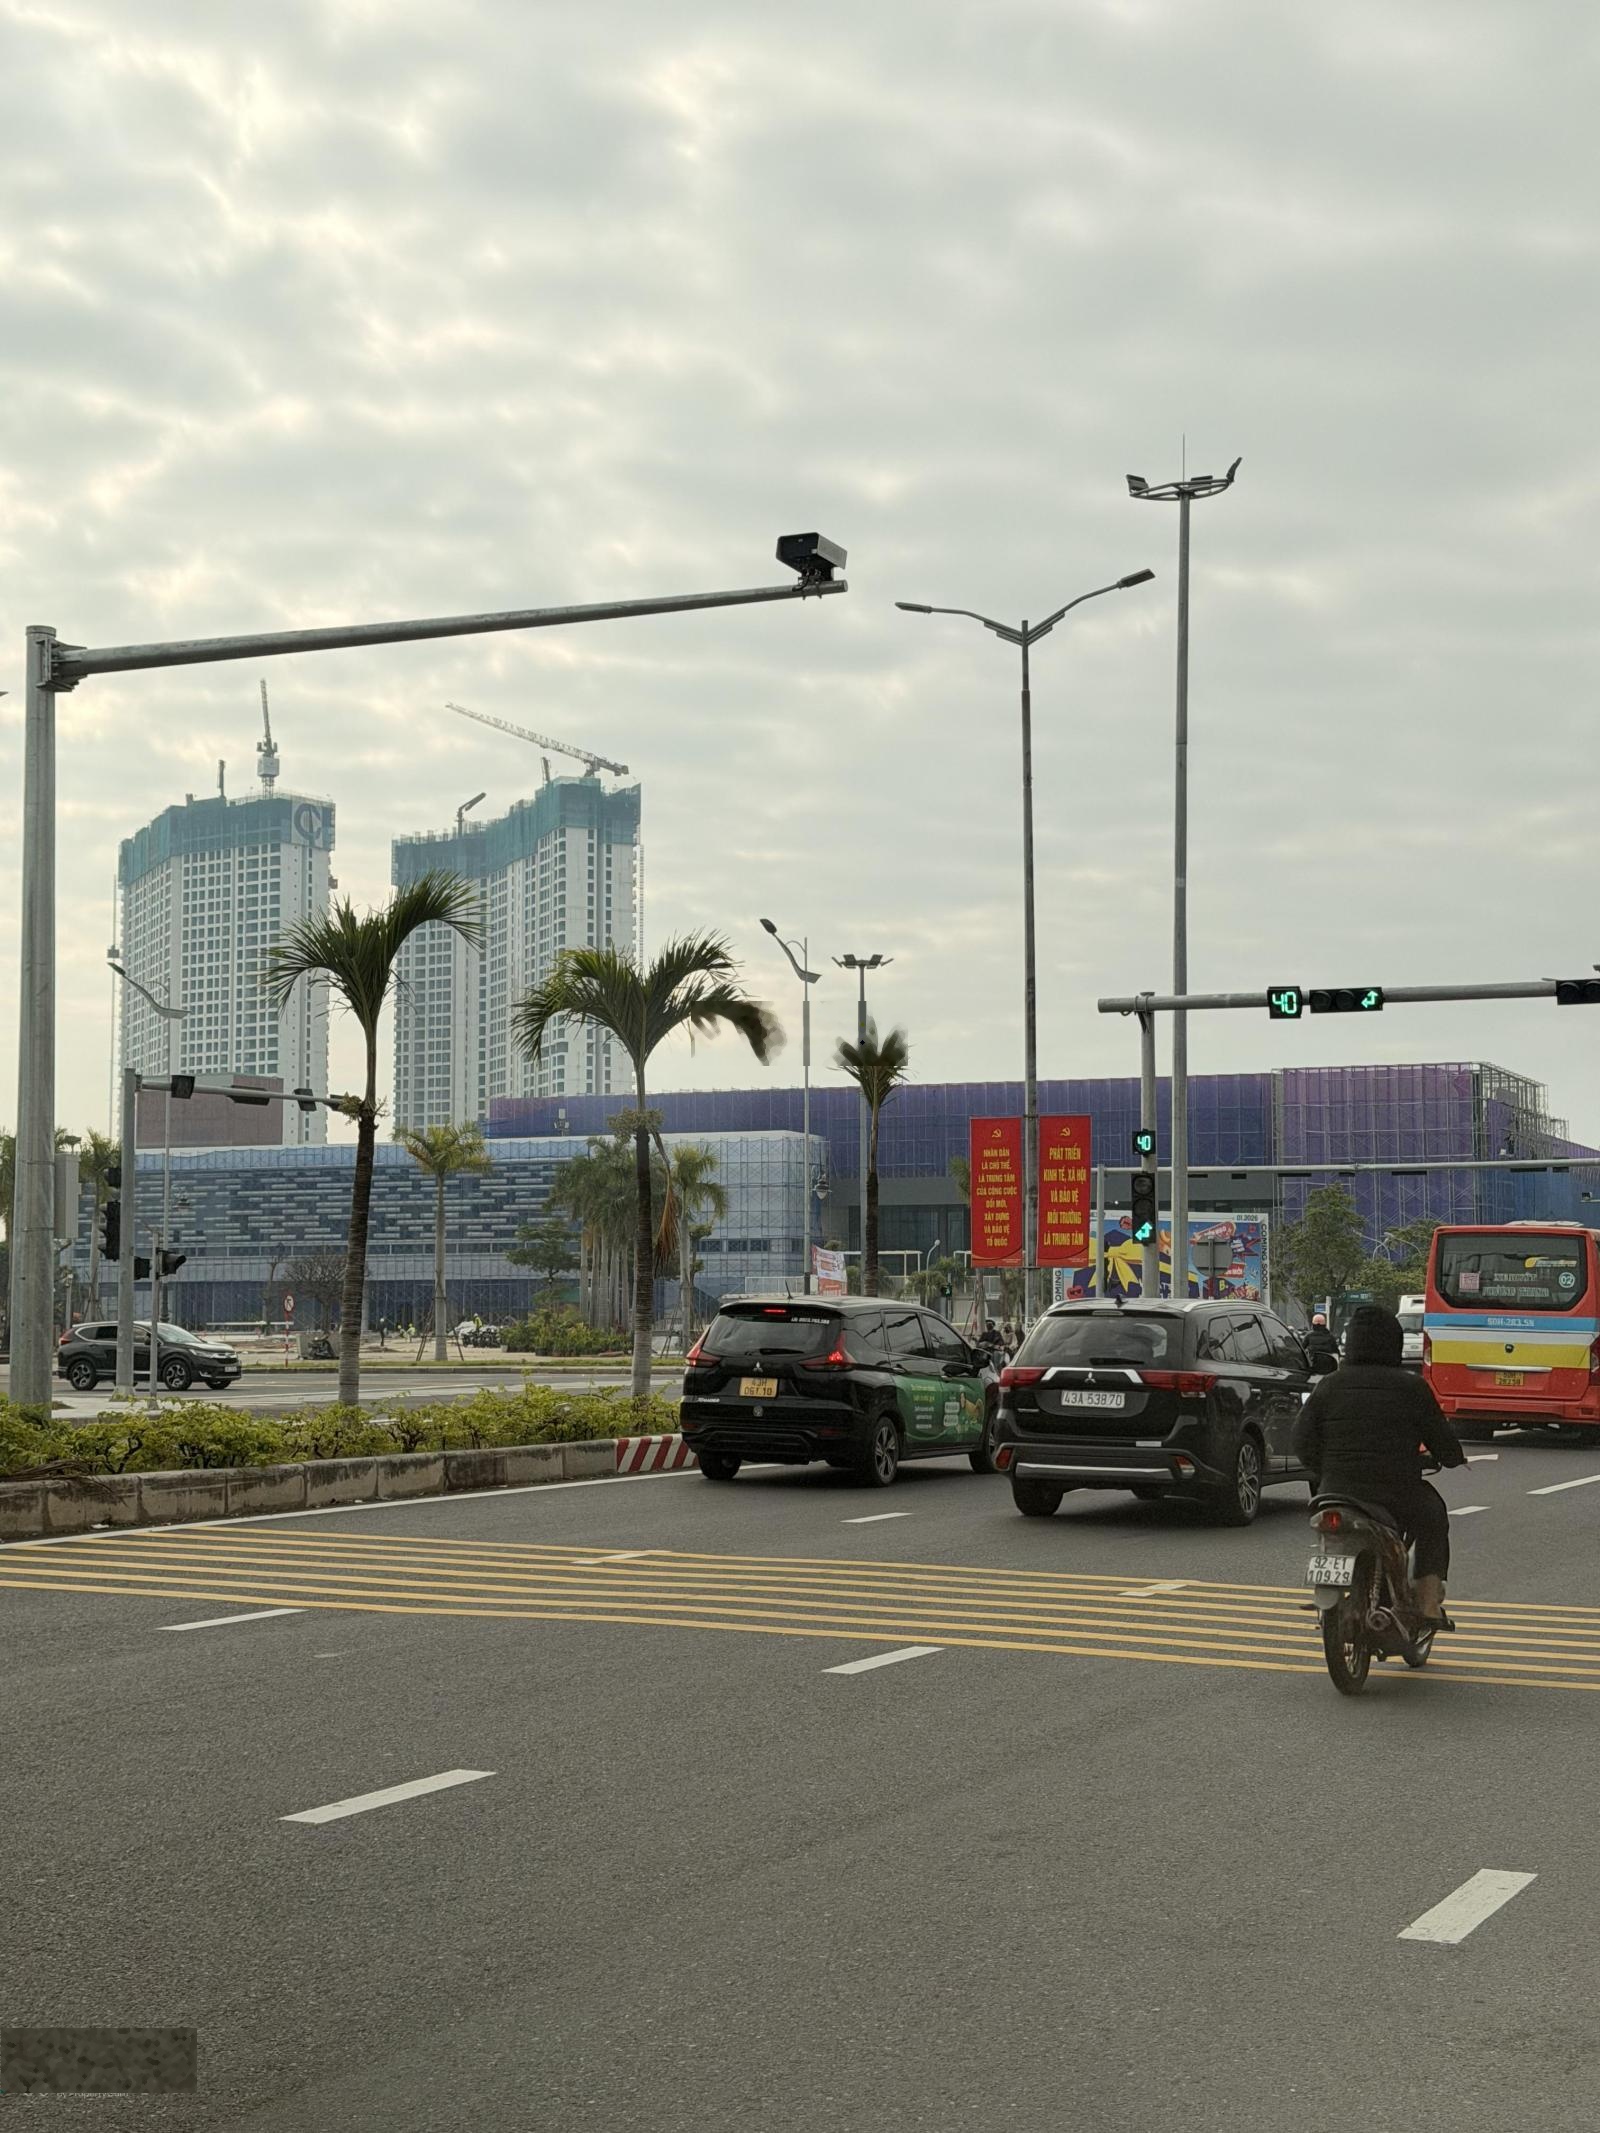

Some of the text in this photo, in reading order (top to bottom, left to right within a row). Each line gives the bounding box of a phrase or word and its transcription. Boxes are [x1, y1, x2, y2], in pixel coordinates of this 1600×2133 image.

[1271, 991, 1297, 1014] 40
[1137, 1135, 1151, 1151] 40
[1049, 1143, 1081, 1160] PHÁT TRIỂN
[1043, 1165, 1087, 1185] KINH TẾ, XÃ HỘI
[1050, 1186, 1079, 1206] VÀ BẢO VỆ
[1047, 1209, 1059, 1225] MÔI
[1059, 1209, 1082, 1225] TRƯỜNG
[1043, 1230, 1083, 1246] LÀ TRUNG TÂM
[1261, 1263, 1269, 1290] SOON
[1561, 1276, 1574, 1286] 02
[1054, 1270, 1062, 1302] OMING
[1064, 1391, 1083, 1404] 43A
[1308, 1570, 1350, 1584] 109.29
